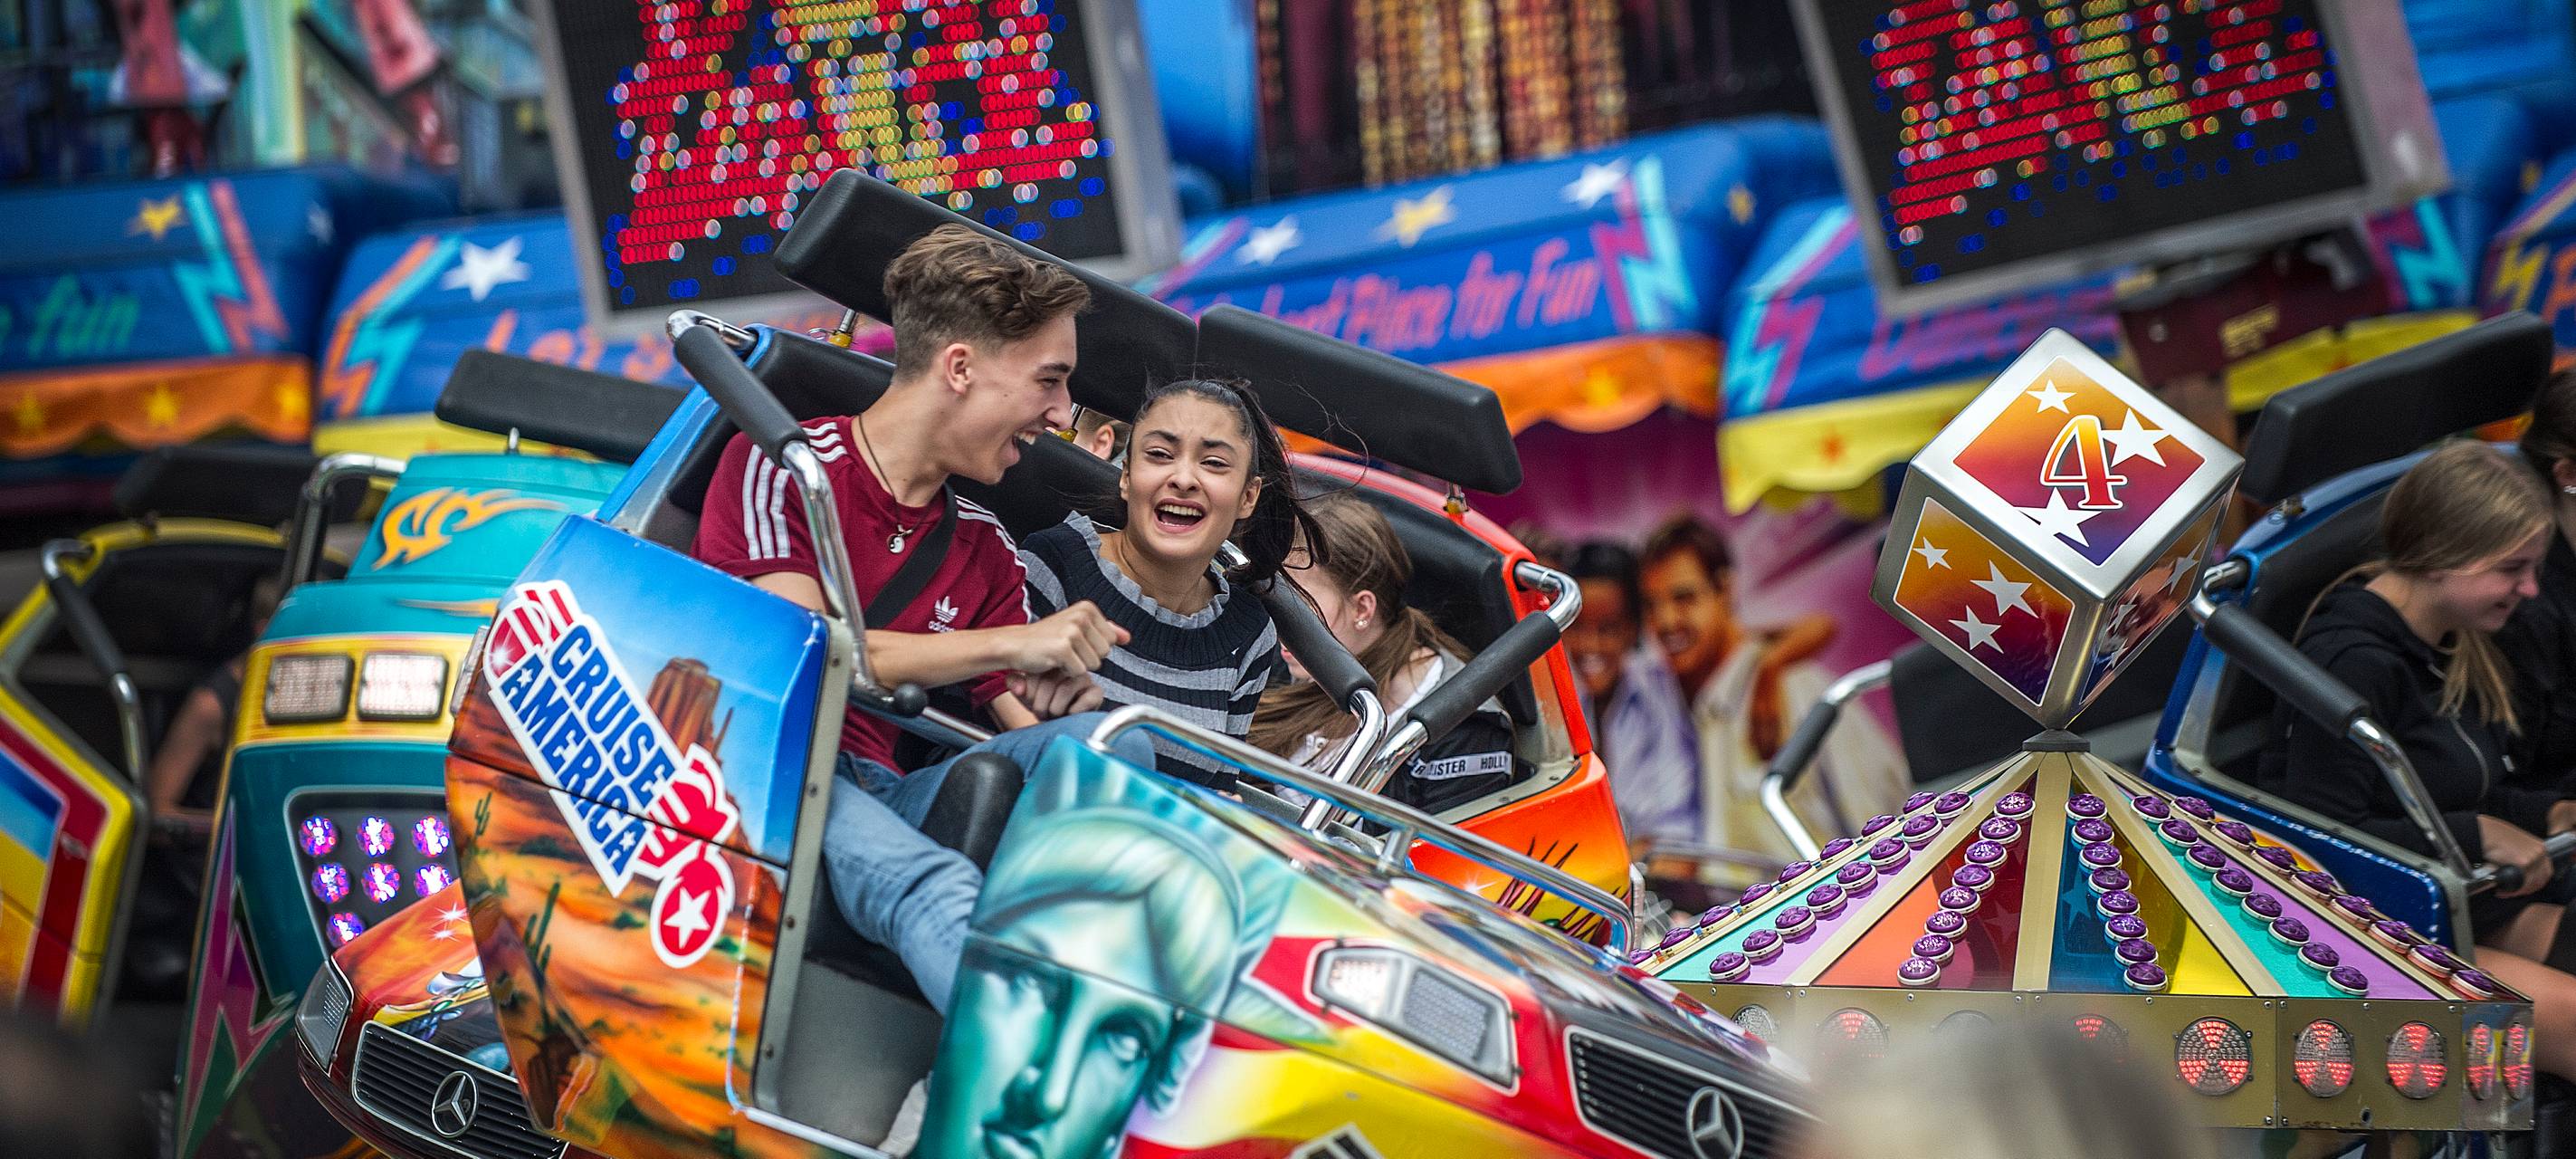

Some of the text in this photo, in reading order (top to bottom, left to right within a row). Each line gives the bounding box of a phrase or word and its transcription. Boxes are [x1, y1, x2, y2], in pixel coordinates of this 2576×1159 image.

[2040, 414, 2128, 509] 4
[499, 652, 647, 876] AMERICA
[550, 624, 675, 809] CRUISE
